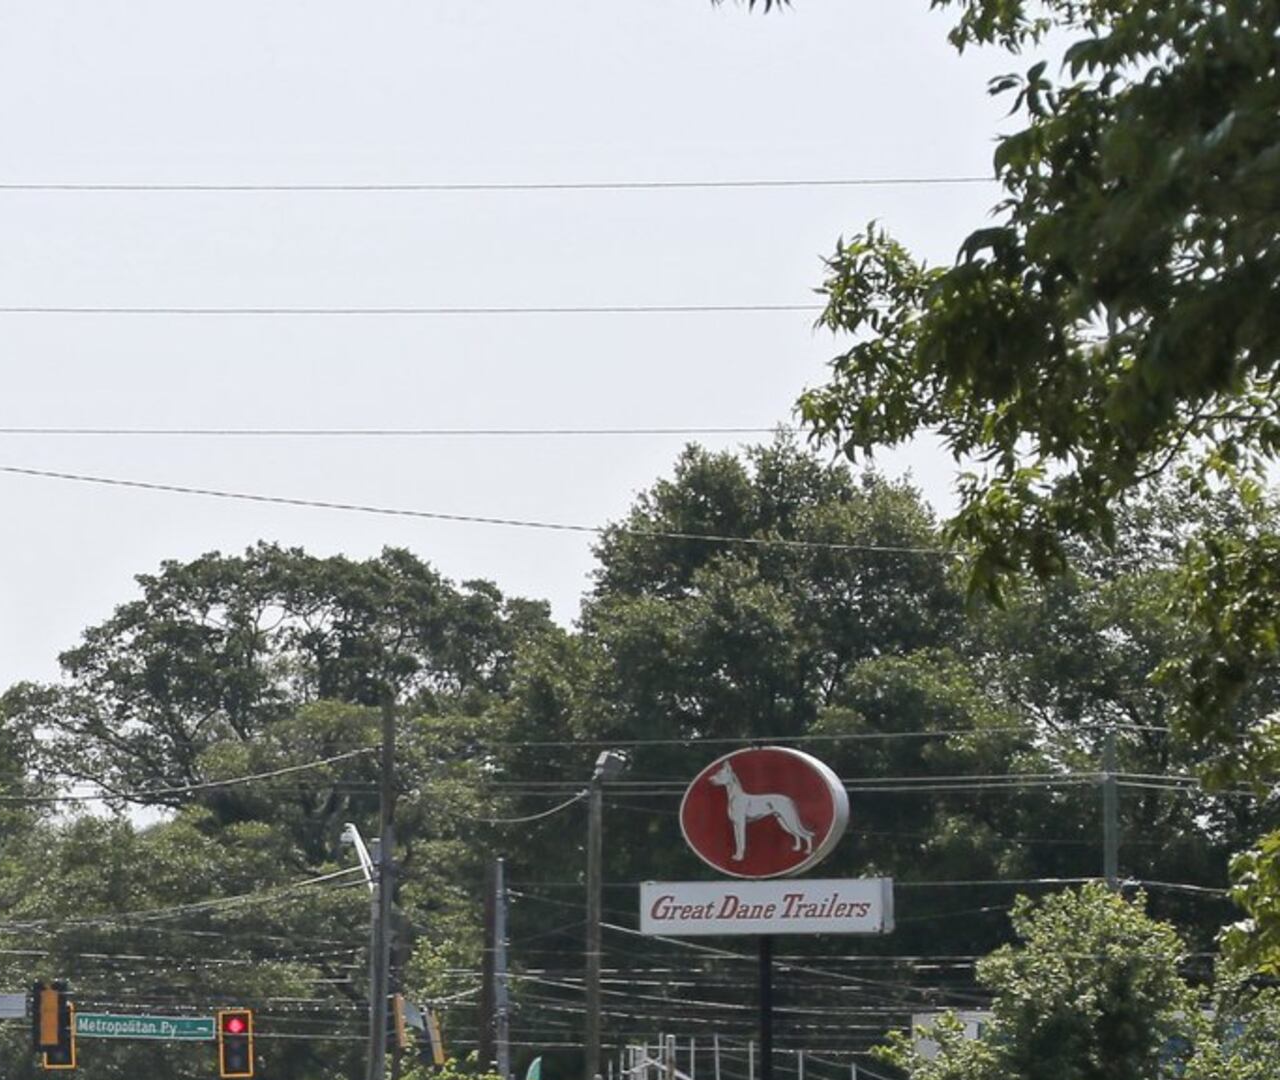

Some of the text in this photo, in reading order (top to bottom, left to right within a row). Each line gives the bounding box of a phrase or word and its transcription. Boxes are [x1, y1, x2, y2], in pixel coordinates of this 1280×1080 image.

[650, 892, 872, 920] Great Dane Trailers
[78, 1017, 156, 1036] Metropolitan
